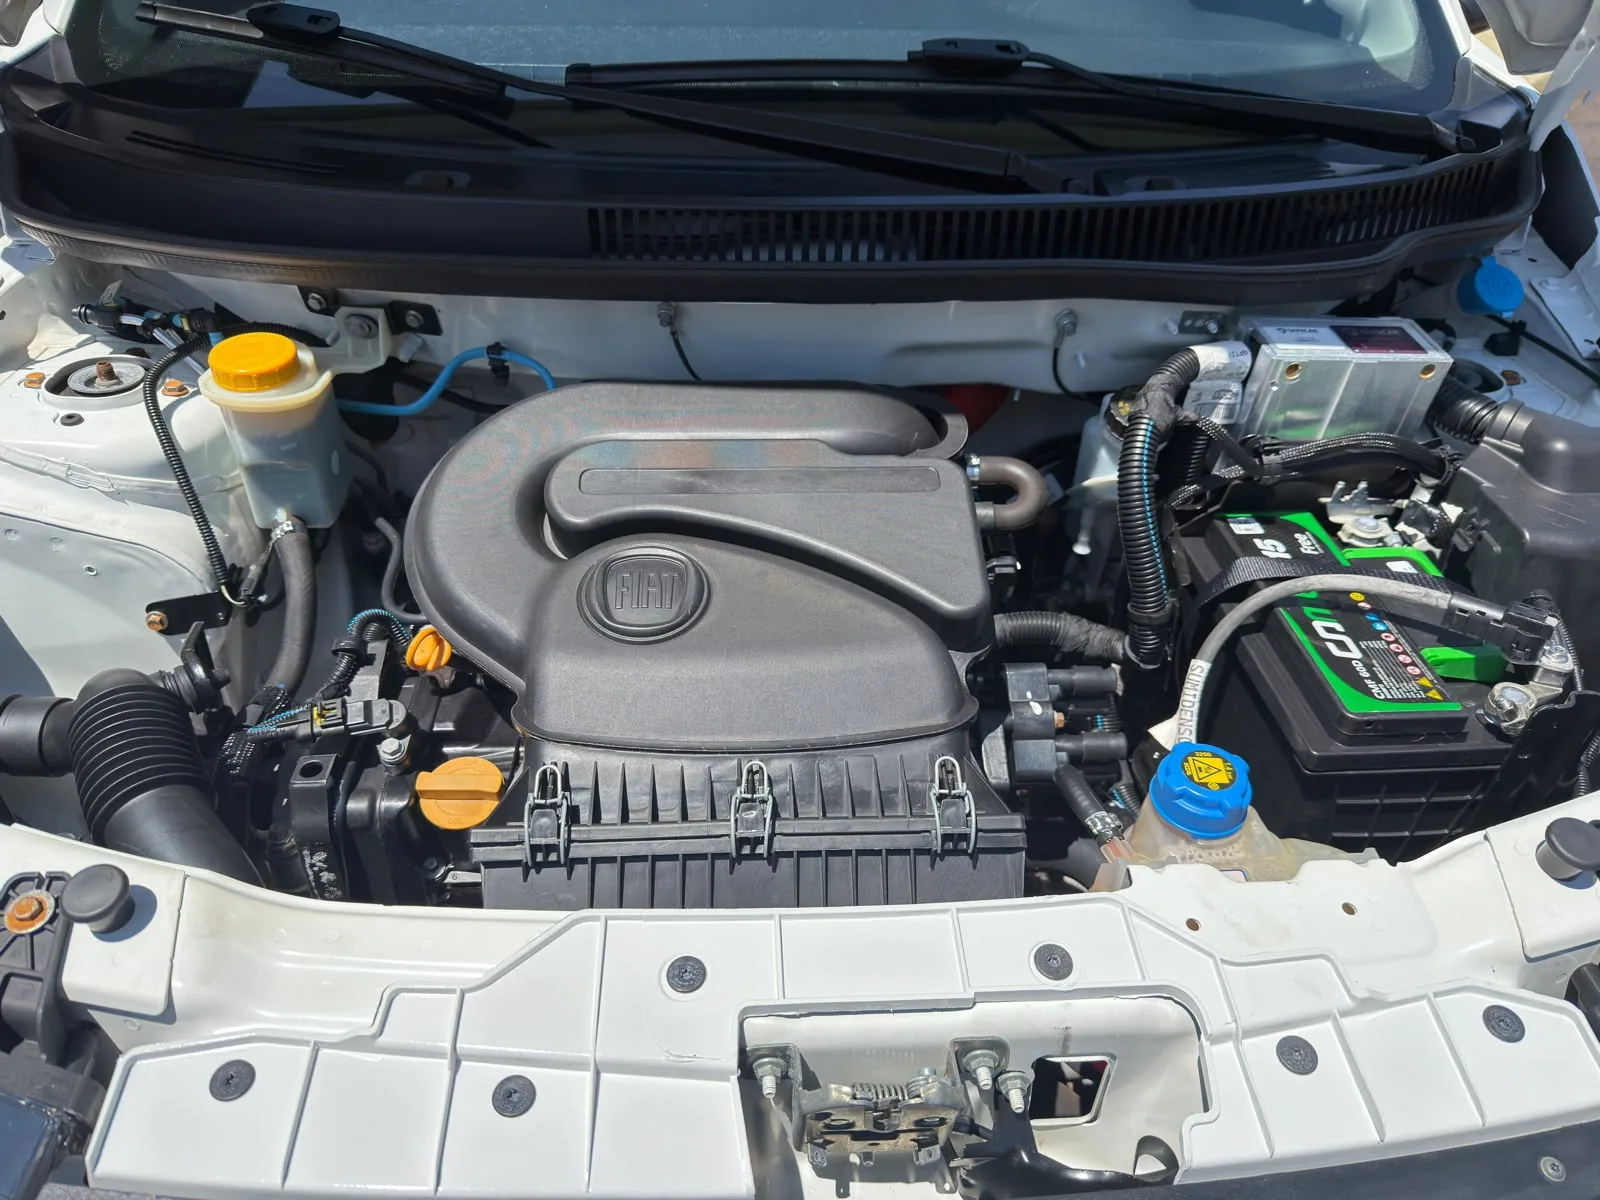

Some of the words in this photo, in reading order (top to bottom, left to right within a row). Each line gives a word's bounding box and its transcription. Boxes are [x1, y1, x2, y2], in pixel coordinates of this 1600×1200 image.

[1252, 538, 1293, 559] 15
[1293, 532, 1320, 555] Free
[615, 571, 679, 609] FIAT
[1351, 659, 1371, 678] 60D
[1363, 678, 1386, 699] CMF
